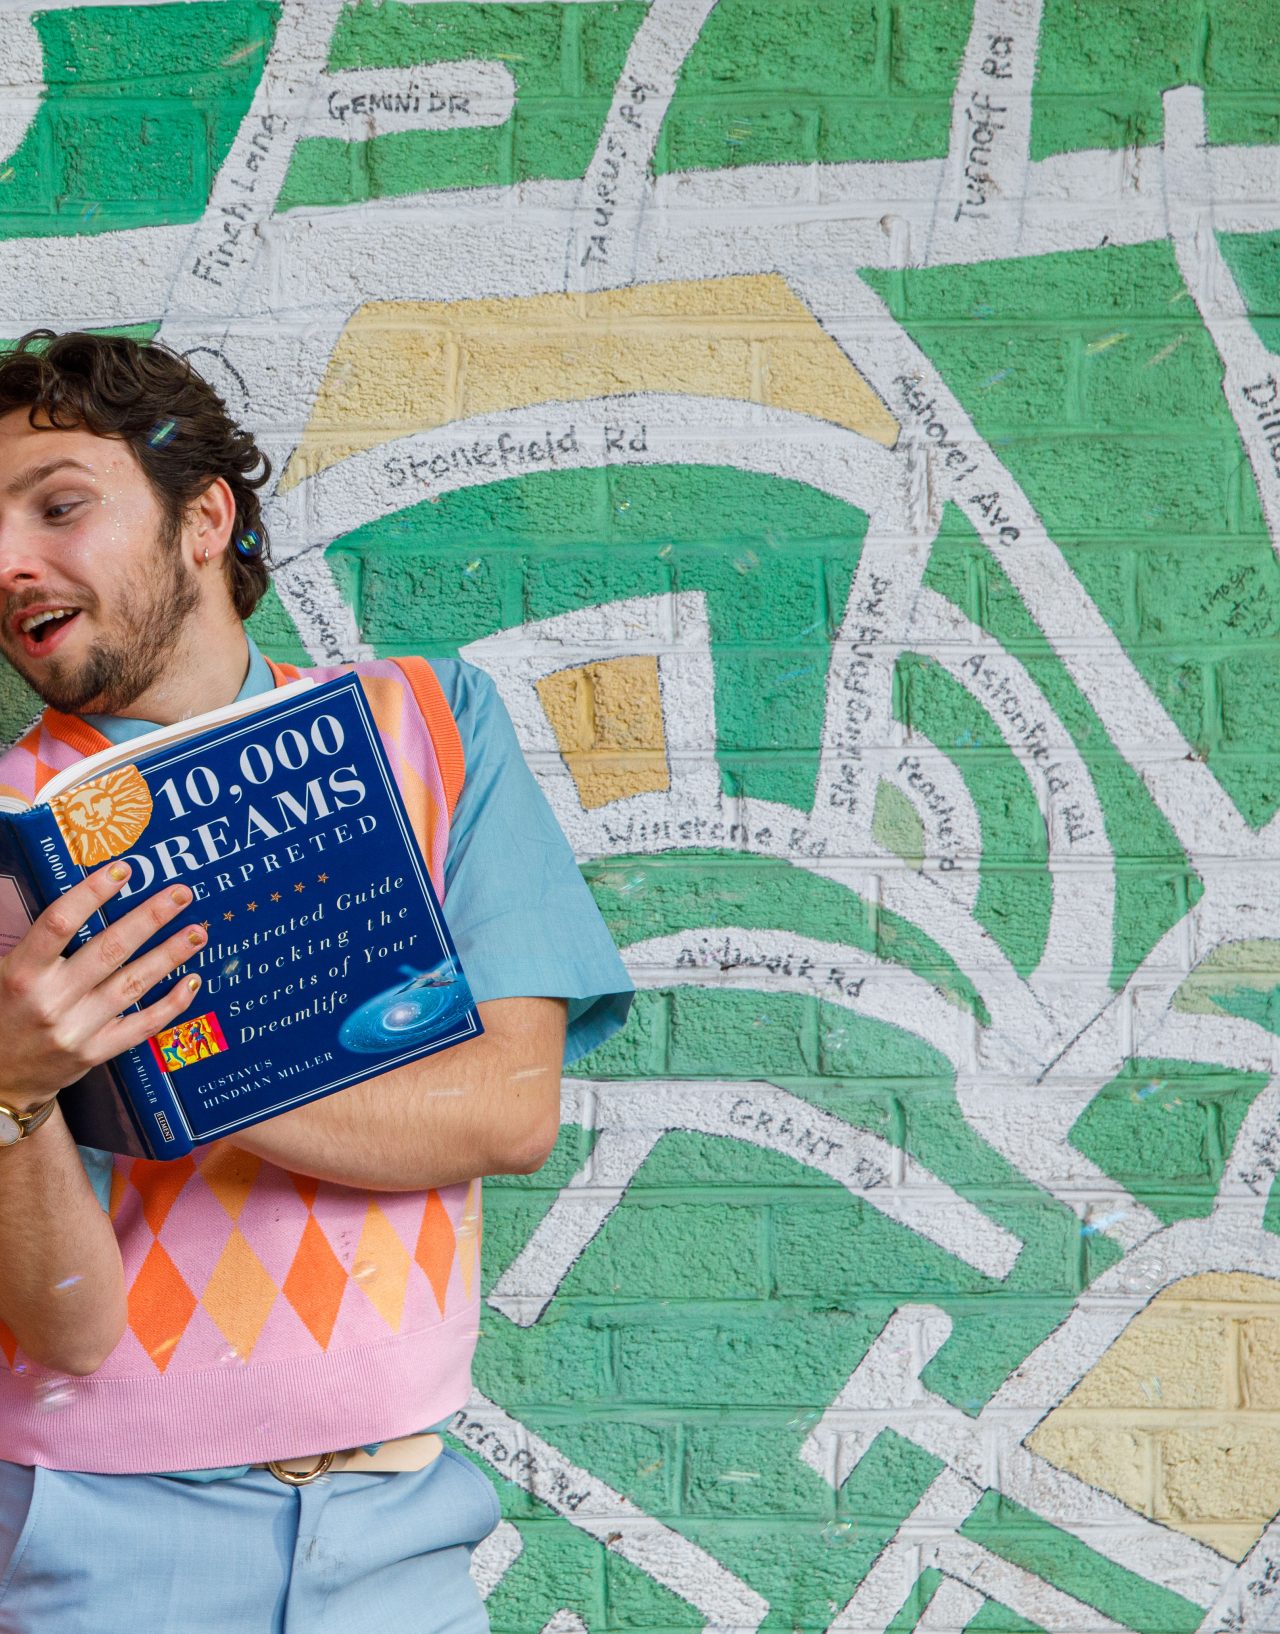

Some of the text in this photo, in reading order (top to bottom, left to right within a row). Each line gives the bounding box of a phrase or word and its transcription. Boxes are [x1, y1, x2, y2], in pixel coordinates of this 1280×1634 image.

[605, 424, 648, 453] Rd
[154, 714, 346, 821] 10,000
[117, 763, 367, 901] DREAMS
[193, 813, 378, 902] ERPRETED
[198, 903, 325, 970] Illustrated
[335, 876, 405, 912] Guide
[205, 905, 409, 995] Unlocking the
[228, 933, 419, 1018] Secrets of Your
[239, 989, 350, 1045] Dreamlife
[197, 1057, 274, 1096] GUSTAVUS
[203, 1050, 335, 1110] HINDMAN MILLER
[727, 1097, 842, 1161] GRANT
[456, 1410, 539, 1481] ncroft
